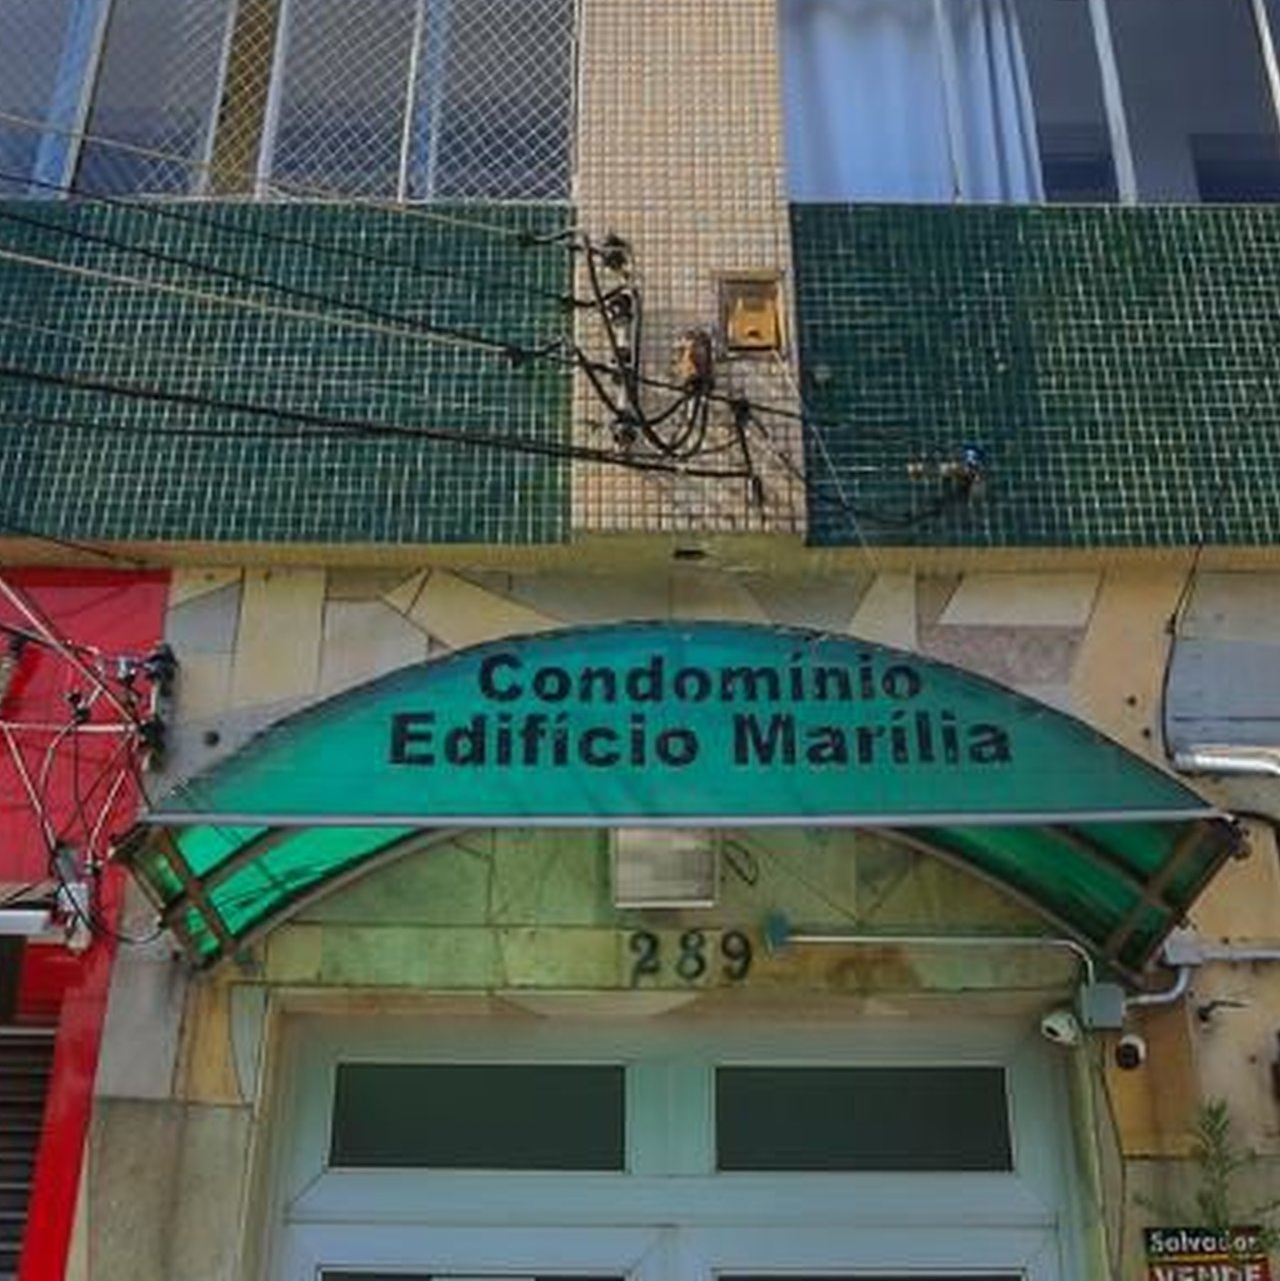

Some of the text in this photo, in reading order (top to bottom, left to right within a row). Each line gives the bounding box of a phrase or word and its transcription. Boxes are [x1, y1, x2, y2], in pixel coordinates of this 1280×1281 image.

[478, 653, 922, 703] Condomínio
[388, 712, 1013, 767] Edifício Marília
[629, 929, 752, 987] 289
